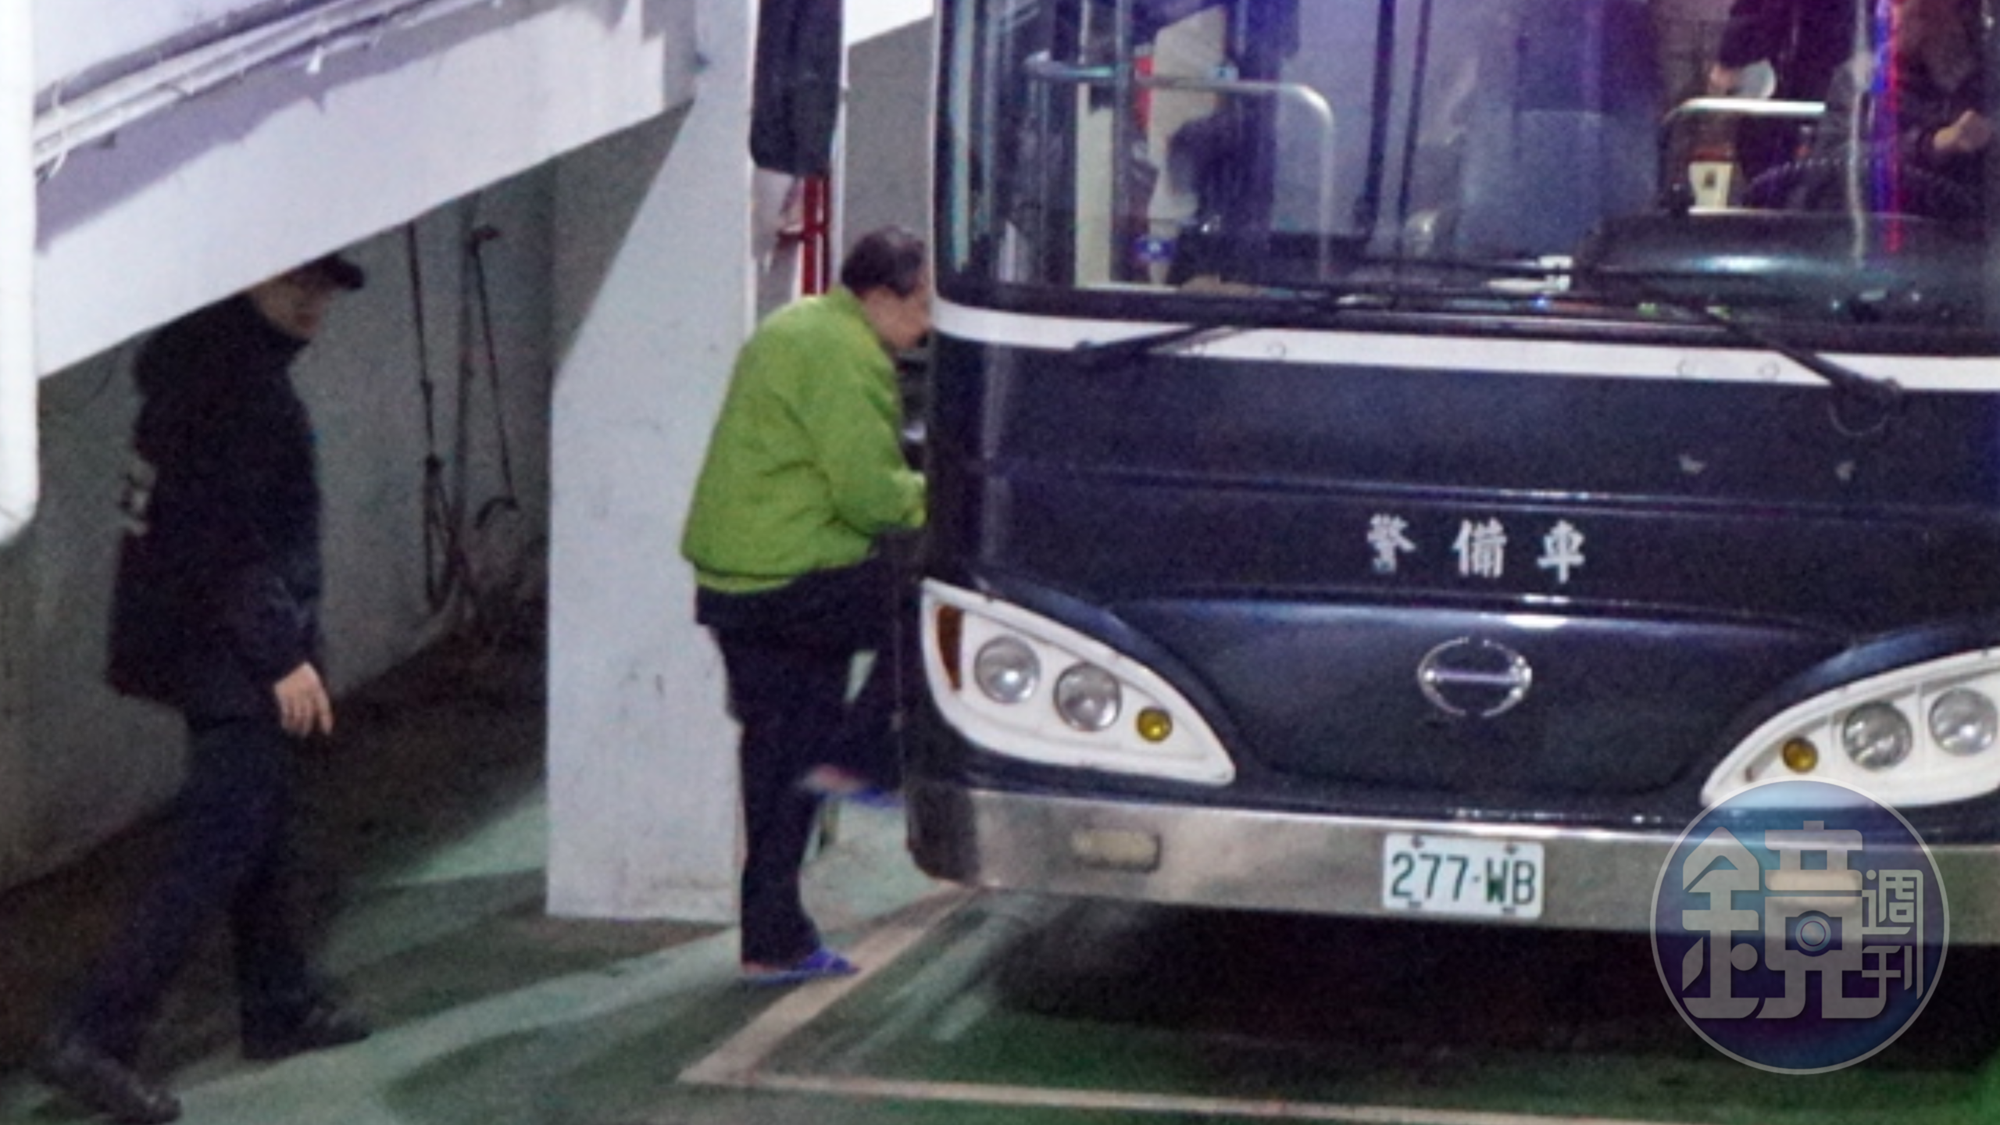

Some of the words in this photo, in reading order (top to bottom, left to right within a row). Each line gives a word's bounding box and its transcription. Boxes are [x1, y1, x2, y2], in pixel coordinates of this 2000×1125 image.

[1367, 513, 1586, 583] 警備車
[1391, 852, 1536, 905] 277-WB
